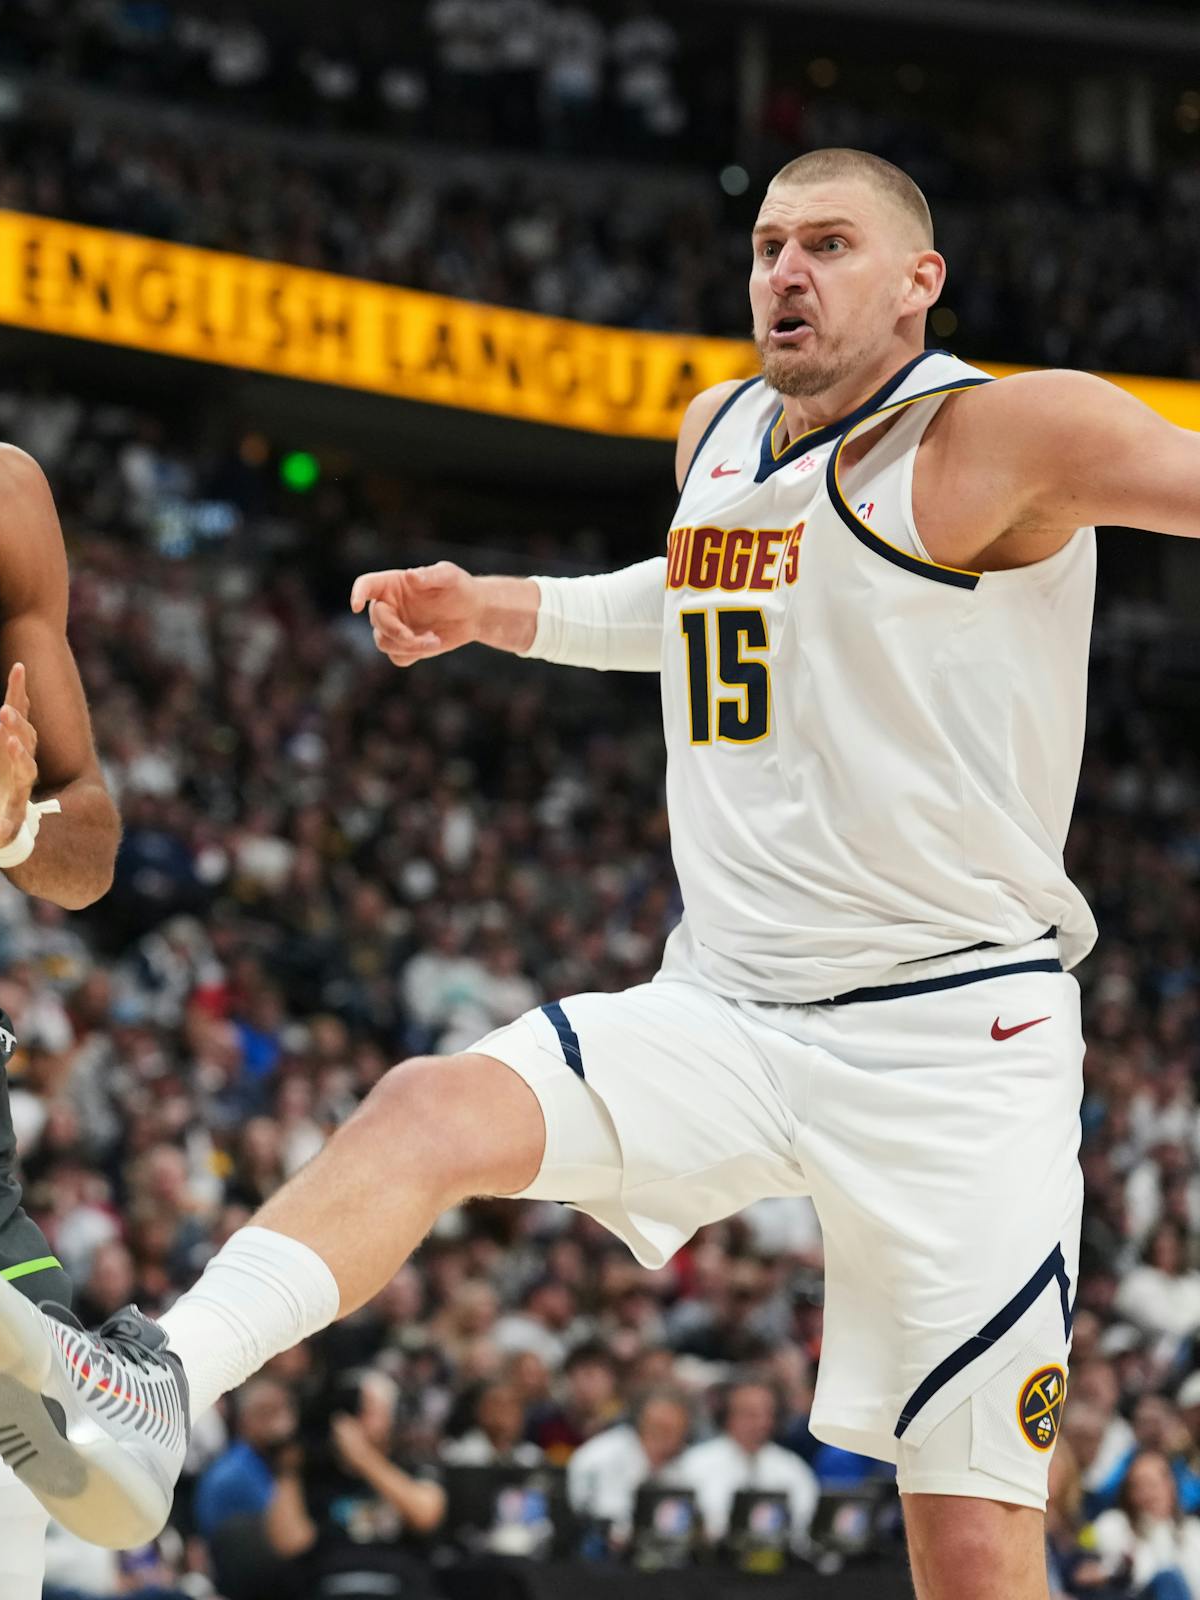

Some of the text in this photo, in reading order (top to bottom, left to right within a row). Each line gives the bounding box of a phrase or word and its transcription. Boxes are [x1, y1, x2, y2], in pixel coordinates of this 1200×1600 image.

[23, 237, 353, 360] ENGLISH
[382, 312, 760, 414] LANGUA
[679, 607, 771, 746] 15
